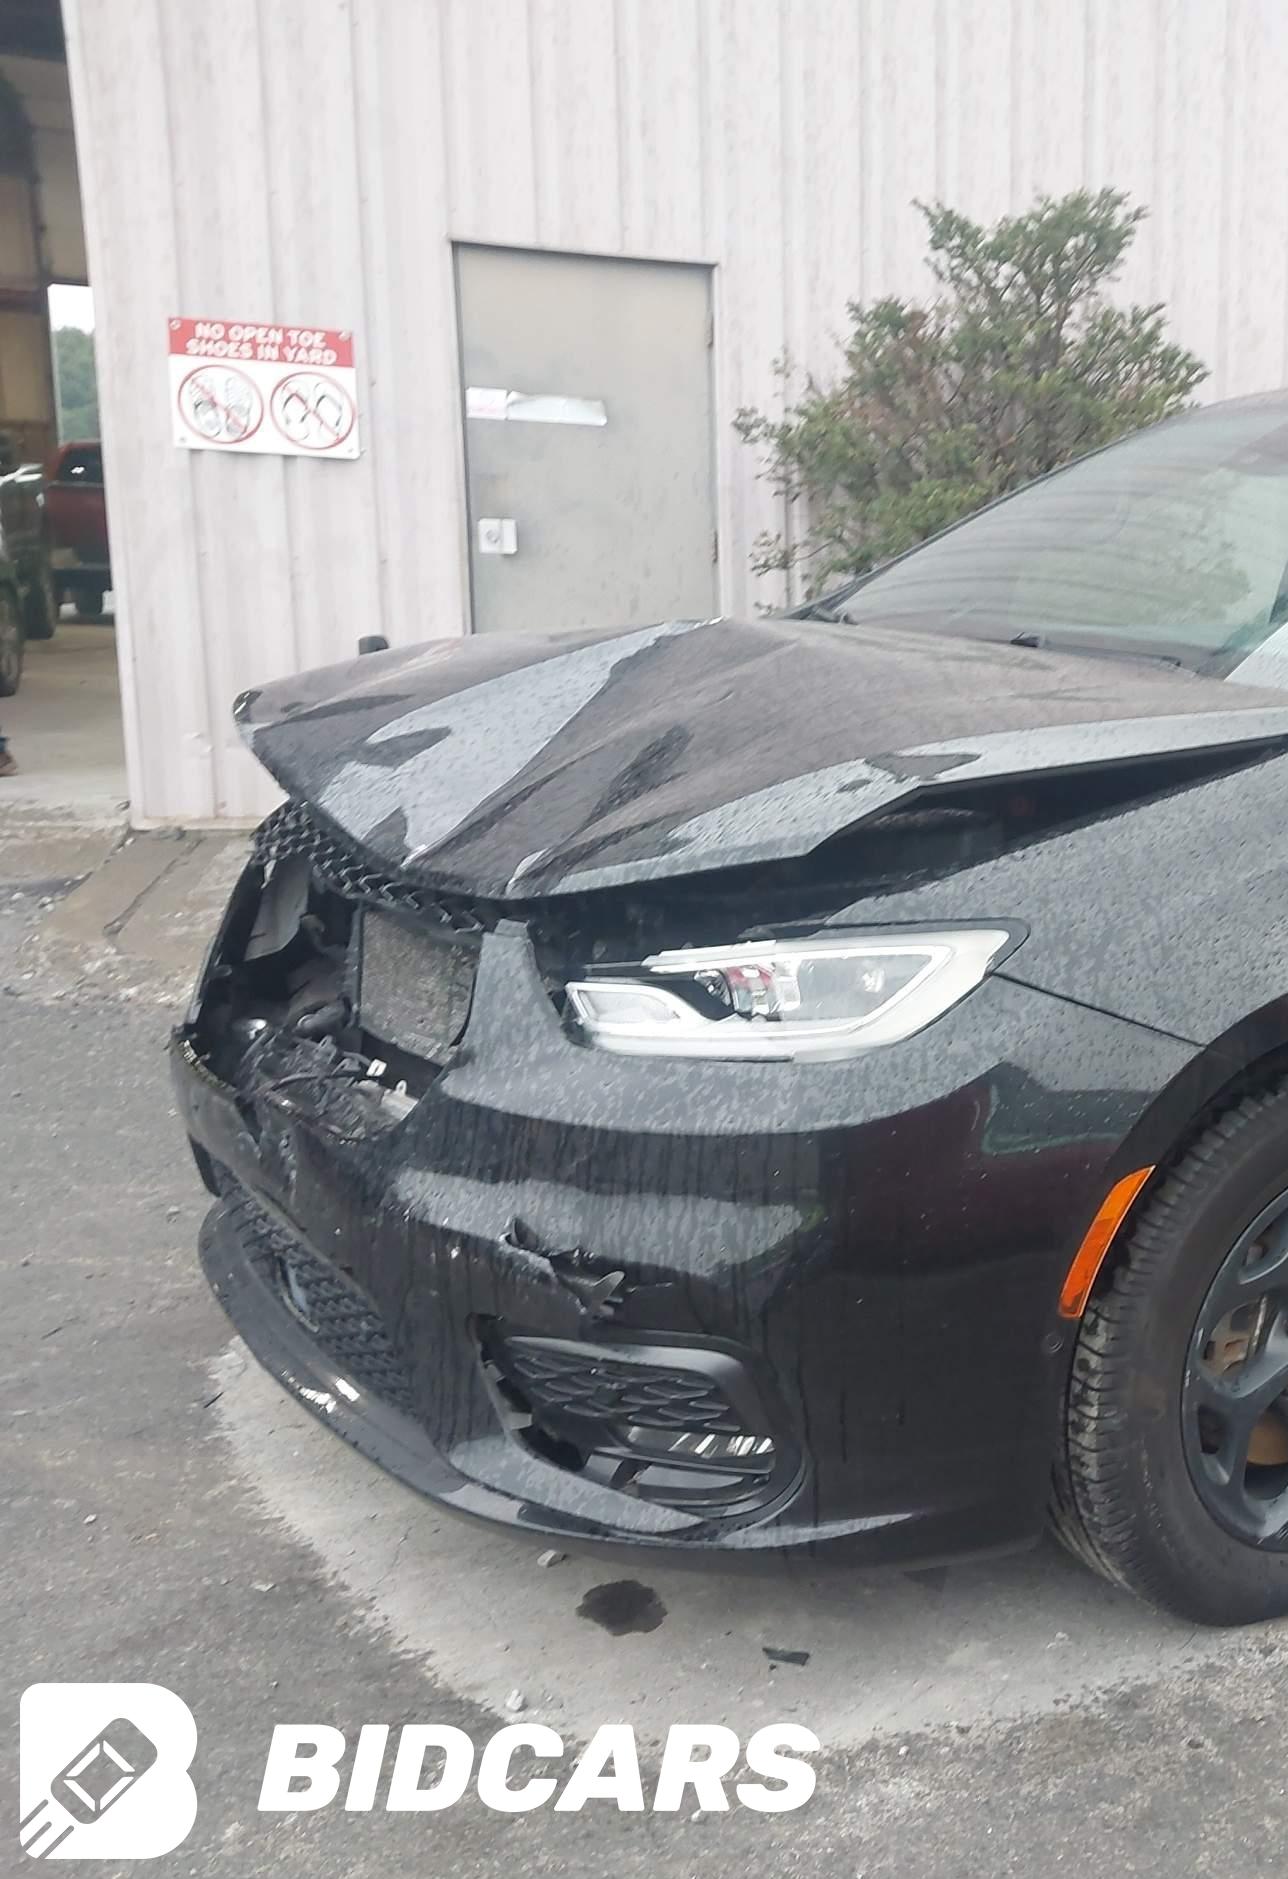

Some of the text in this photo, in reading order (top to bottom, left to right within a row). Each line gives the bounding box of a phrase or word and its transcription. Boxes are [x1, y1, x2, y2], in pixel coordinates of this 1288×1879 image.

[195, 322, 326, 348] NO OPEN TOE
[185, 339, 338, 366] SHOES IN YARD
